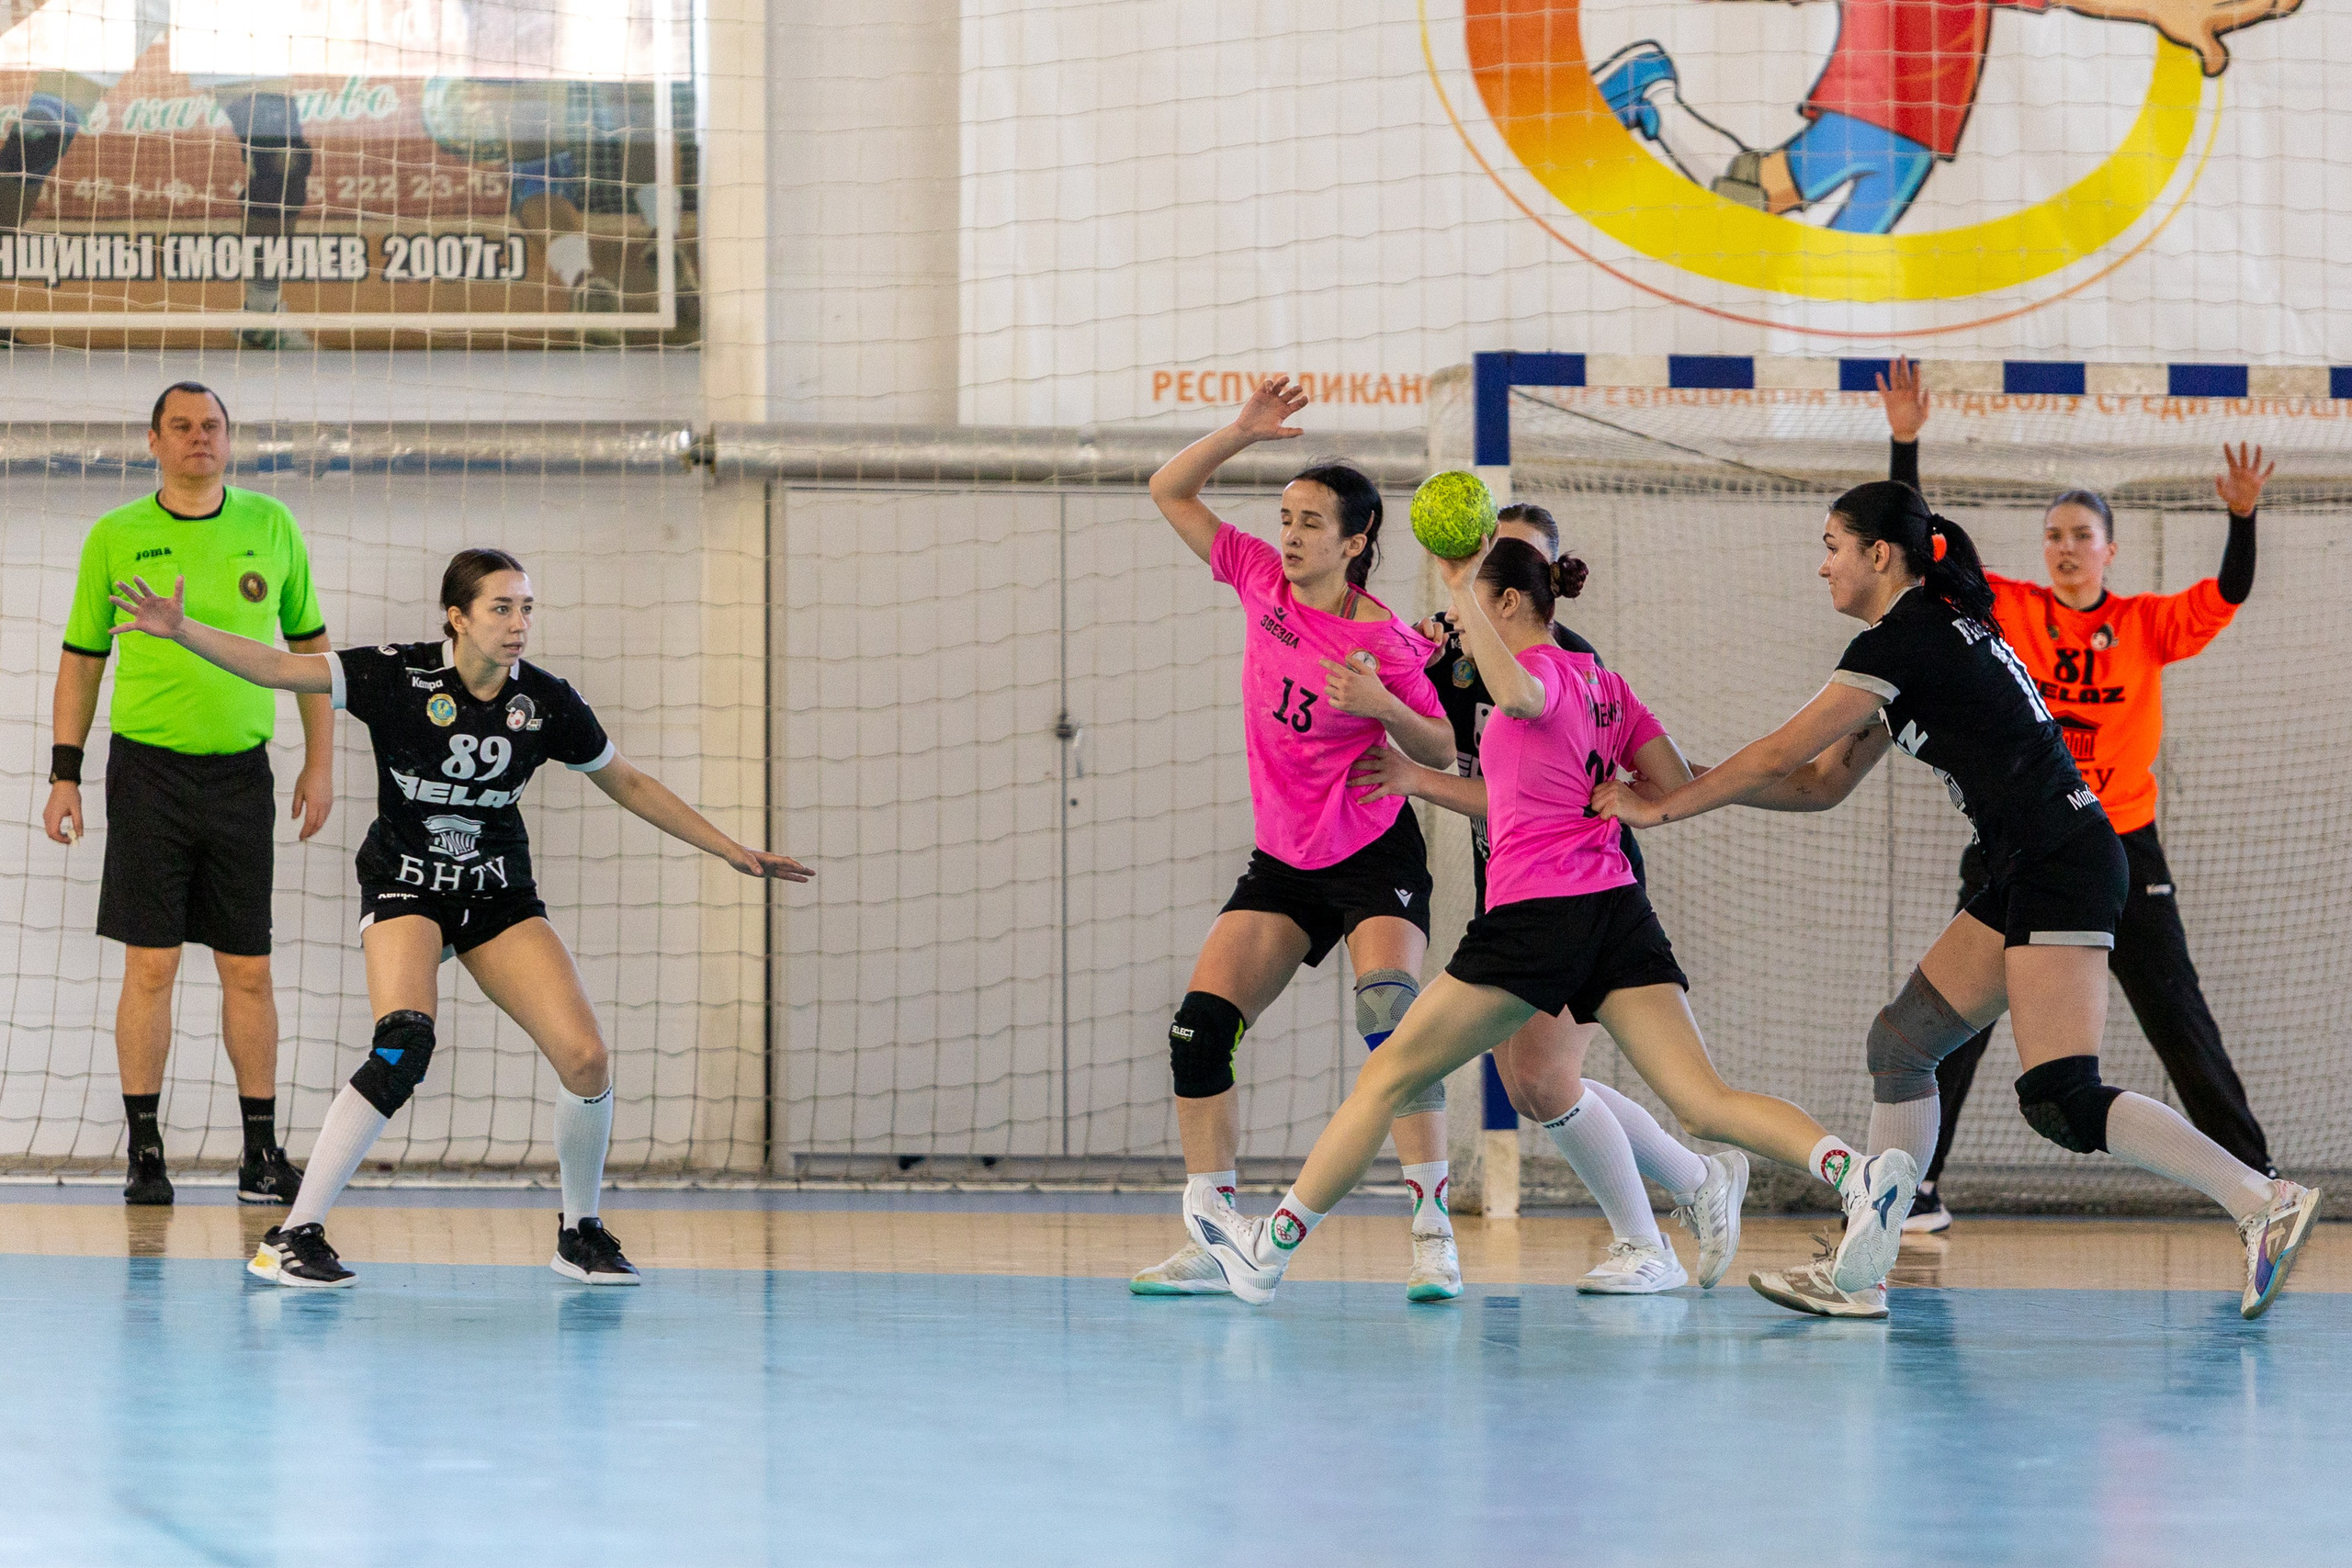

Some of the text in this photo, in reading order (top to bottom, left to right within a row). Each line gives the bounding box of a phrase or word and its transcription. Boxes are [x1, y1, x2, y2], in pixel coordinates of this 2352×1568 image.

[1260, 614, 1301, 649] ЗВЕЗДА
[412, 676, 443, 692] Kempa
[2054, 648, 2095, 685] 81
[1272, 676, 1319, 734] 13
[2033, 678, 2126, 705] ELAZ
[441, 733, 513, 781] 89
[395, 853, 509, 892] БНТУ
